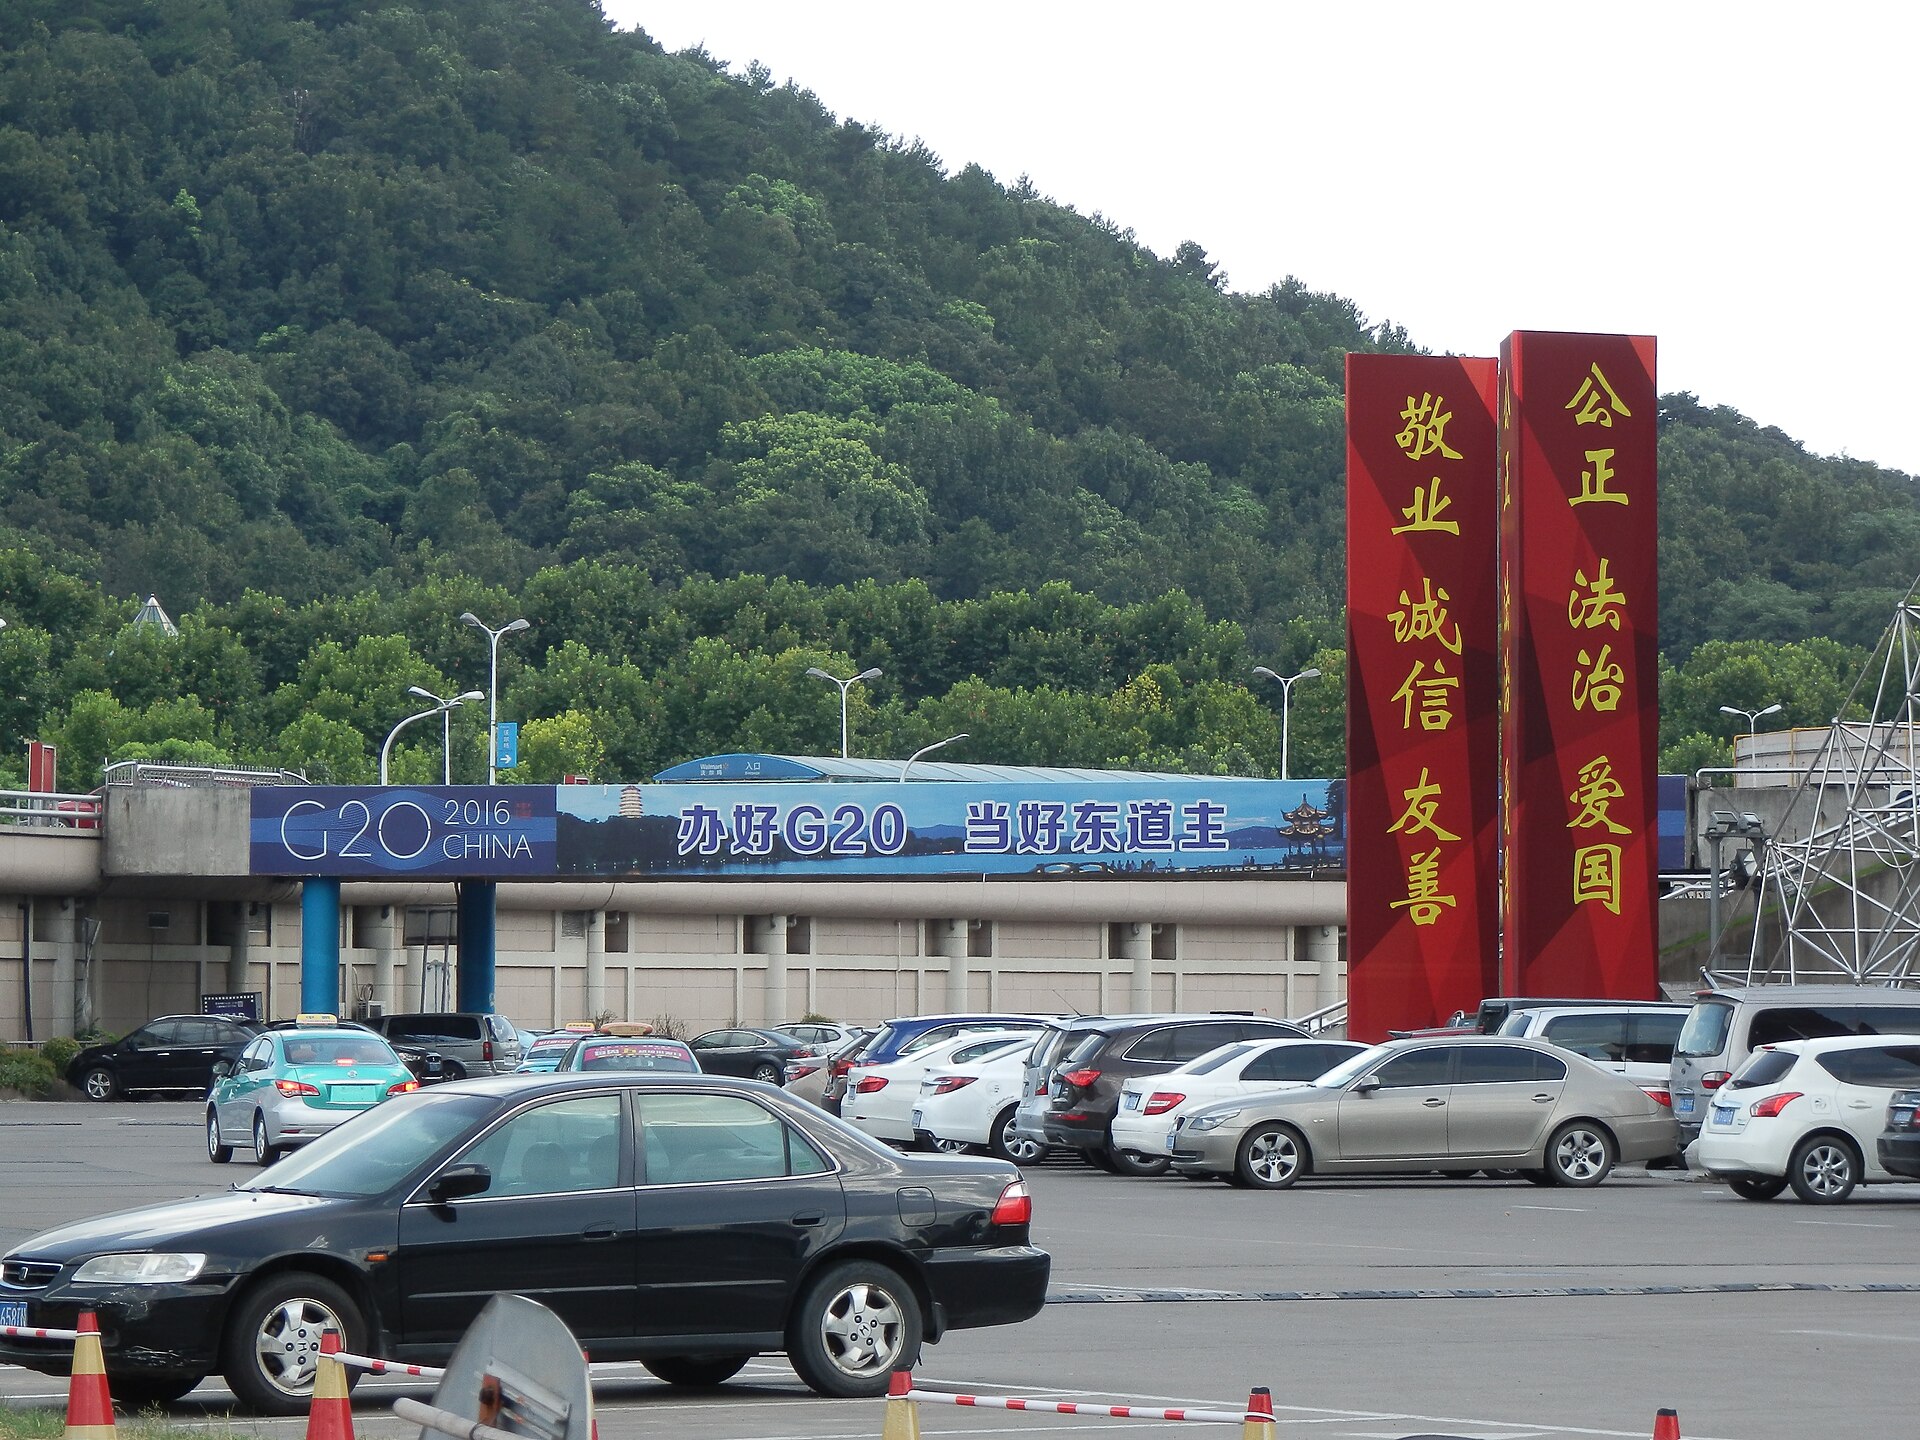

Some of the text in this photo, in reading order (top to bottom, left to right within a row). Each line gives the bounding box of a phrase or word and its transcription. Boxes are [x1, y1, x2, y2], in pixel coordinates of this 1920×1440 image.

[1386, 391, 1464, 926] 敬业 诚信 友善
[1565, 362, 1633, 916] 公正 法治 爱国
[745, 762, 760, 770] 入口
[281, 800, 431, 860] G20
[444, 799, 510, 825] 2016
[679, 801, 1230, 855] 办好G20 当好东道主
[442, 834, 533, 859] CHINA
